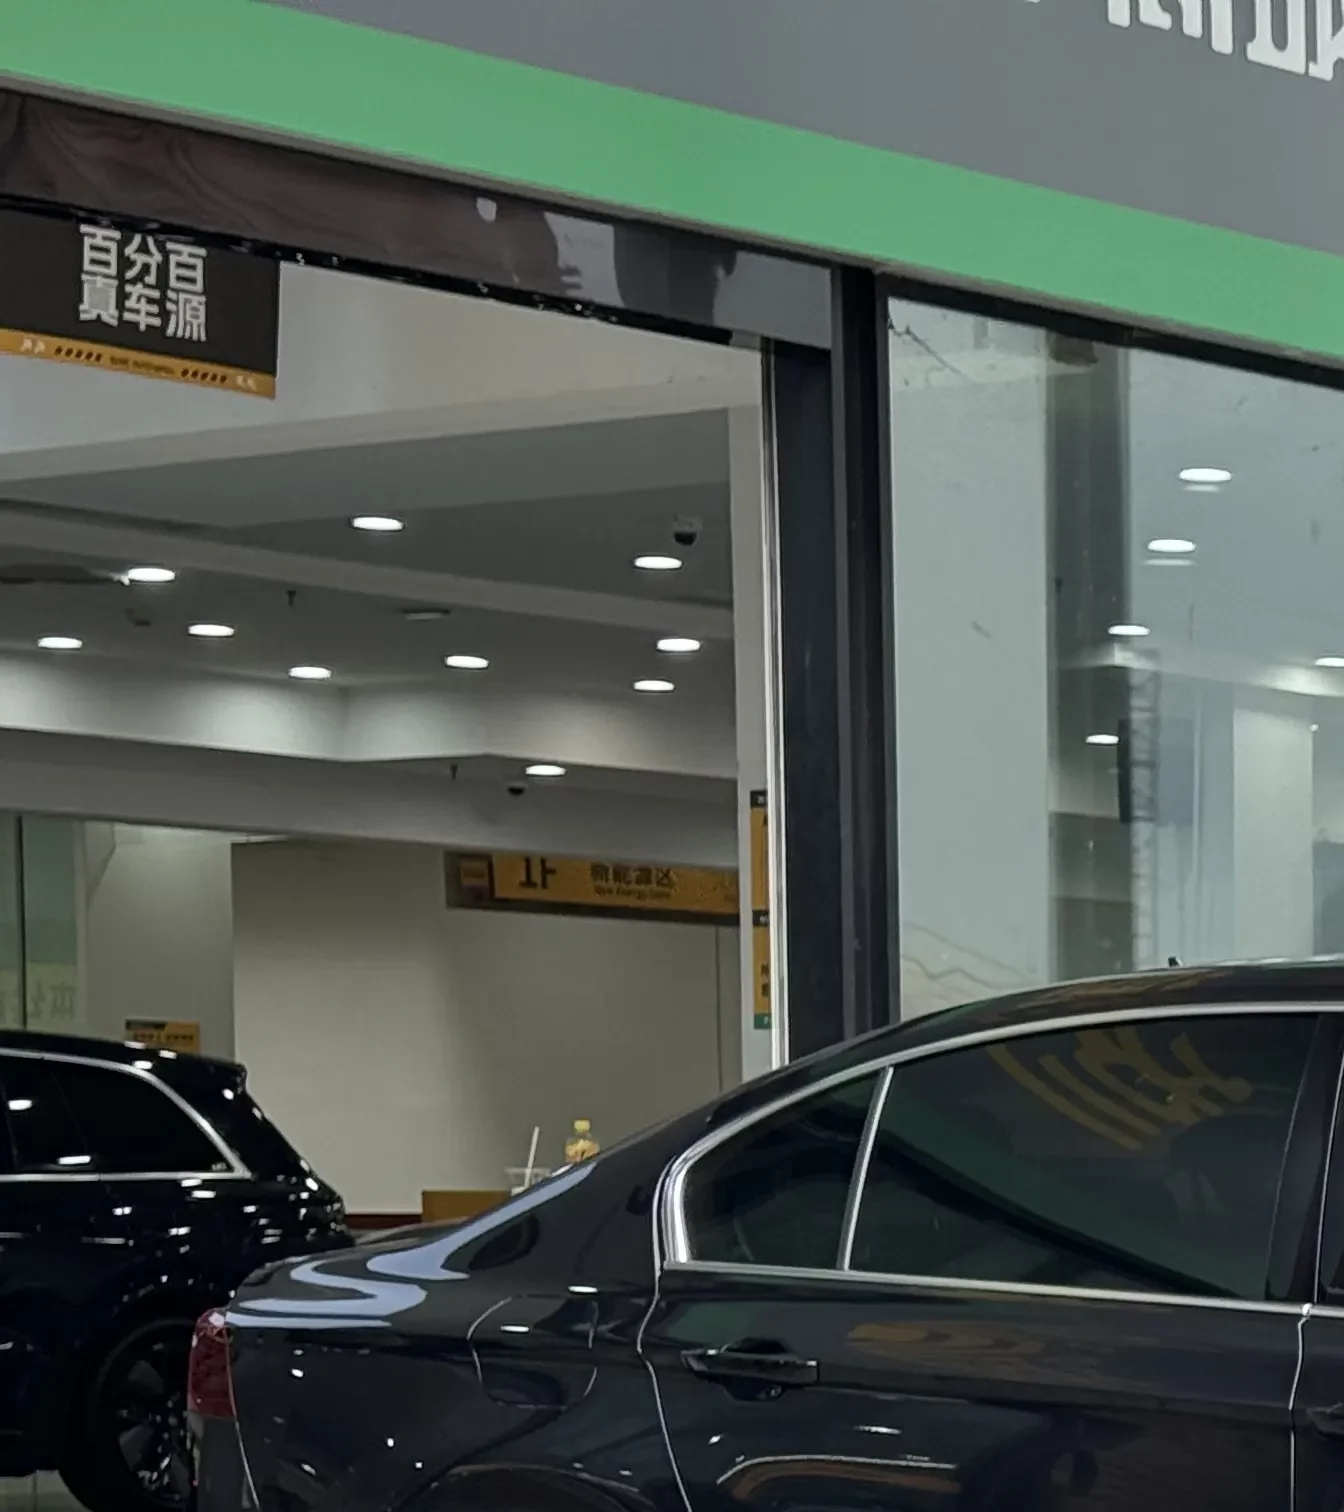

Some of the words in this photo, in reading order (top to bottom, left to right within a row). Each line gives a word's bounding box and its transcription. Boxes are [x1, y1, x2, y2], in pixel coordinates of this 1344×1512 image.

[79, 223, 207, 294] 百分百
[78, 273, 208, 342] 真车源
